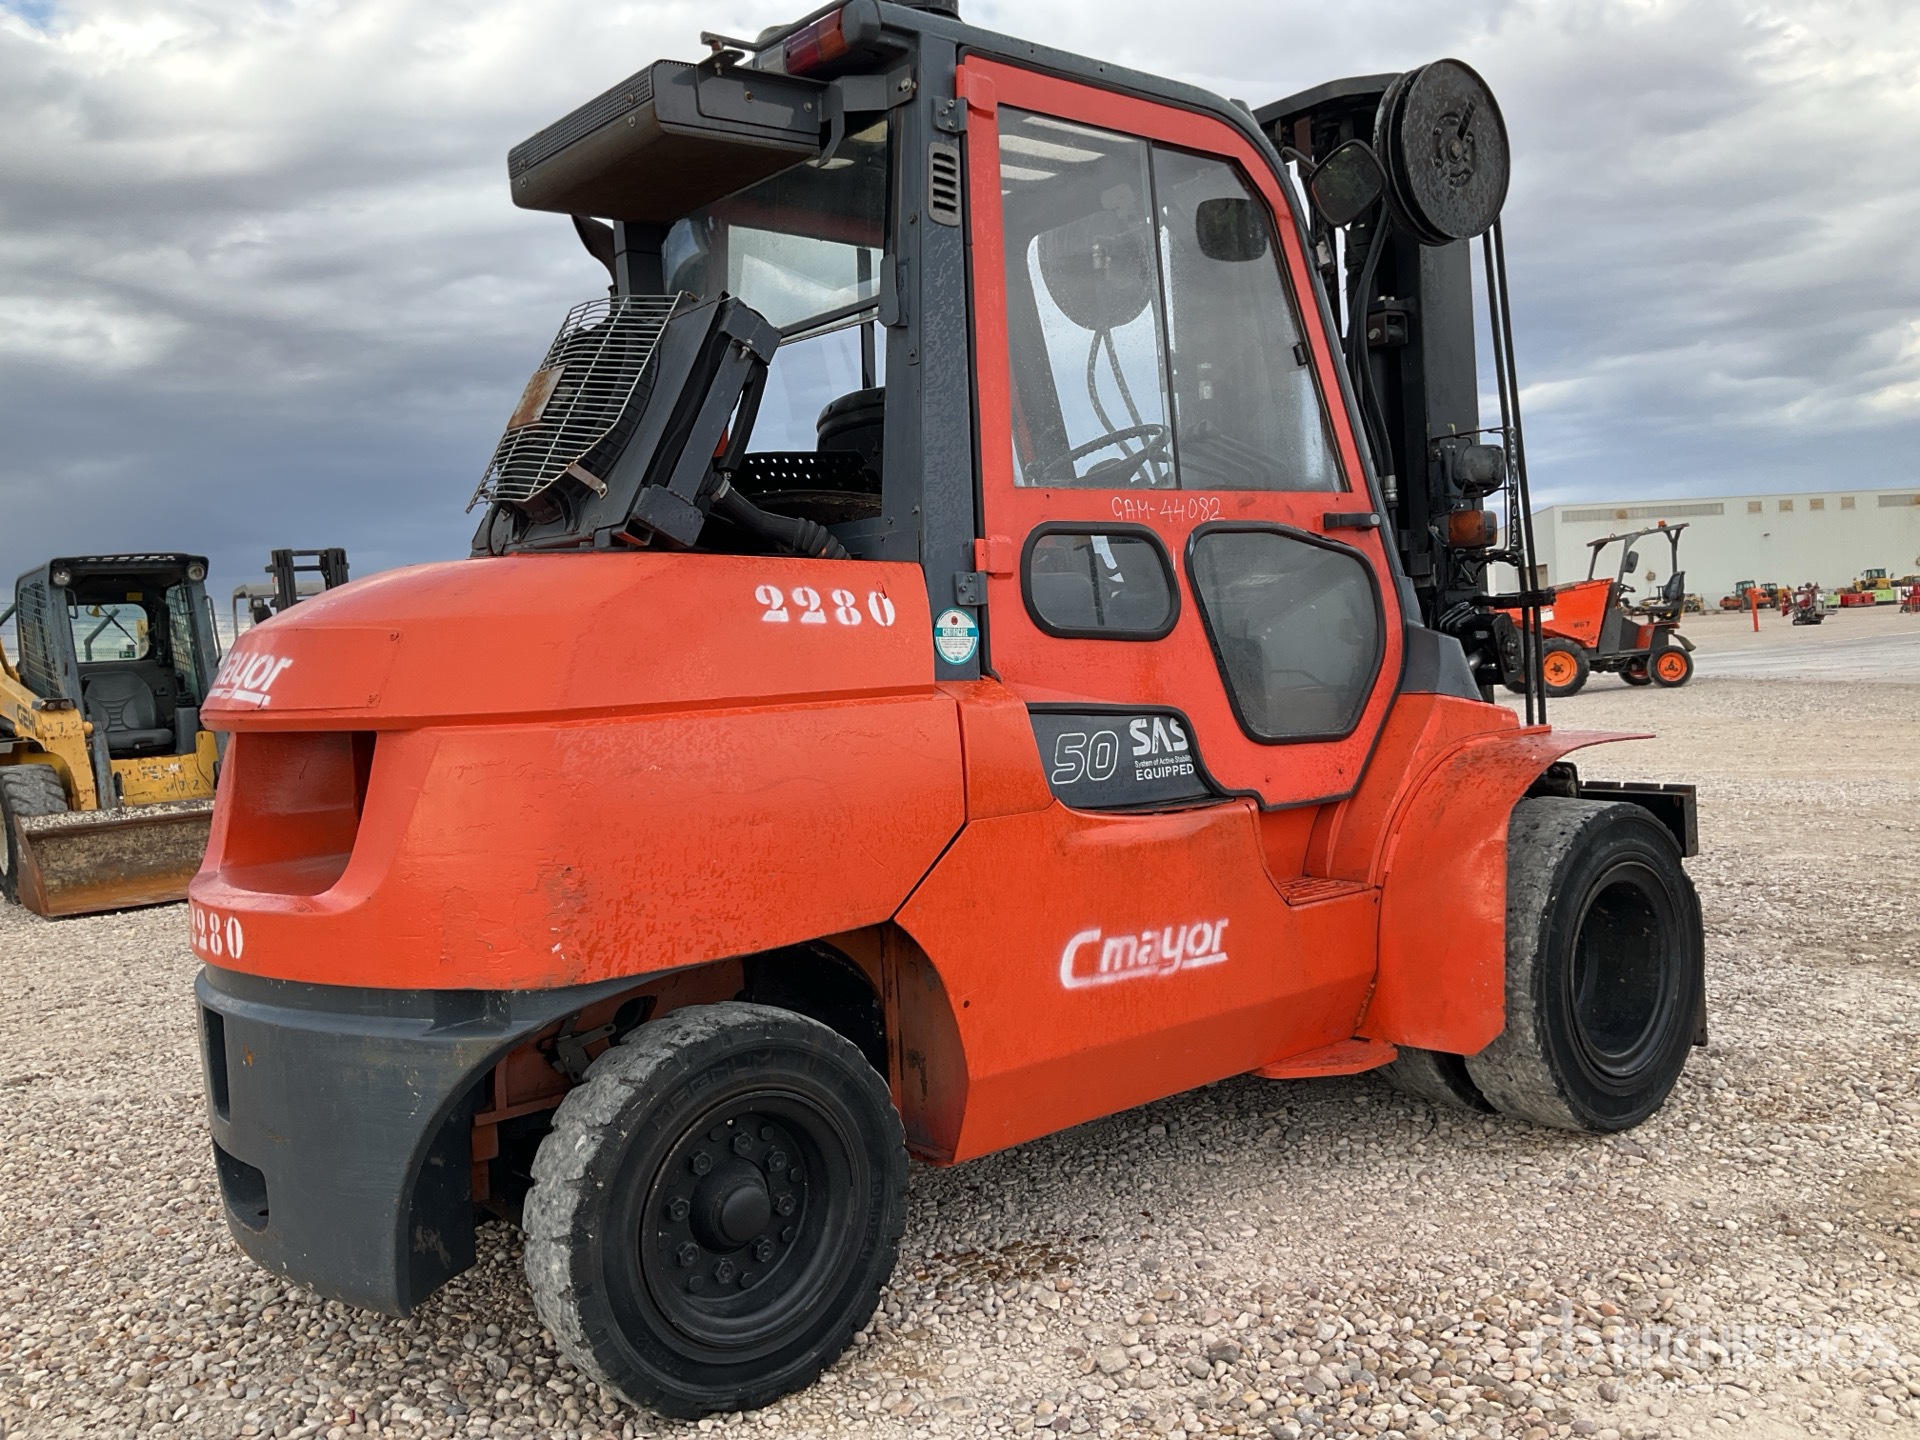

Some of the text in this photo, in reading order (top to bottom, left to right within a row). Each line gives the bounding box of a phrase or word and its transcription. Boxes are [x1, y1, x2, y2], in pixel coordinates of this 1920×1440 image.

[1111, 496, 1226, 523] GAM-44082
[754, 583, 897, 628] 2280
[1129, 716, 1189, 756] SAS
[1051, 729, 1119, 785] 50
[1134, 760, 1153, 768] System
[1160, 757, 1175, 765] Active
[1135, 763, 1194, 781] EQUIPPED
[1059, 917, 1230, 989] Cmayor
